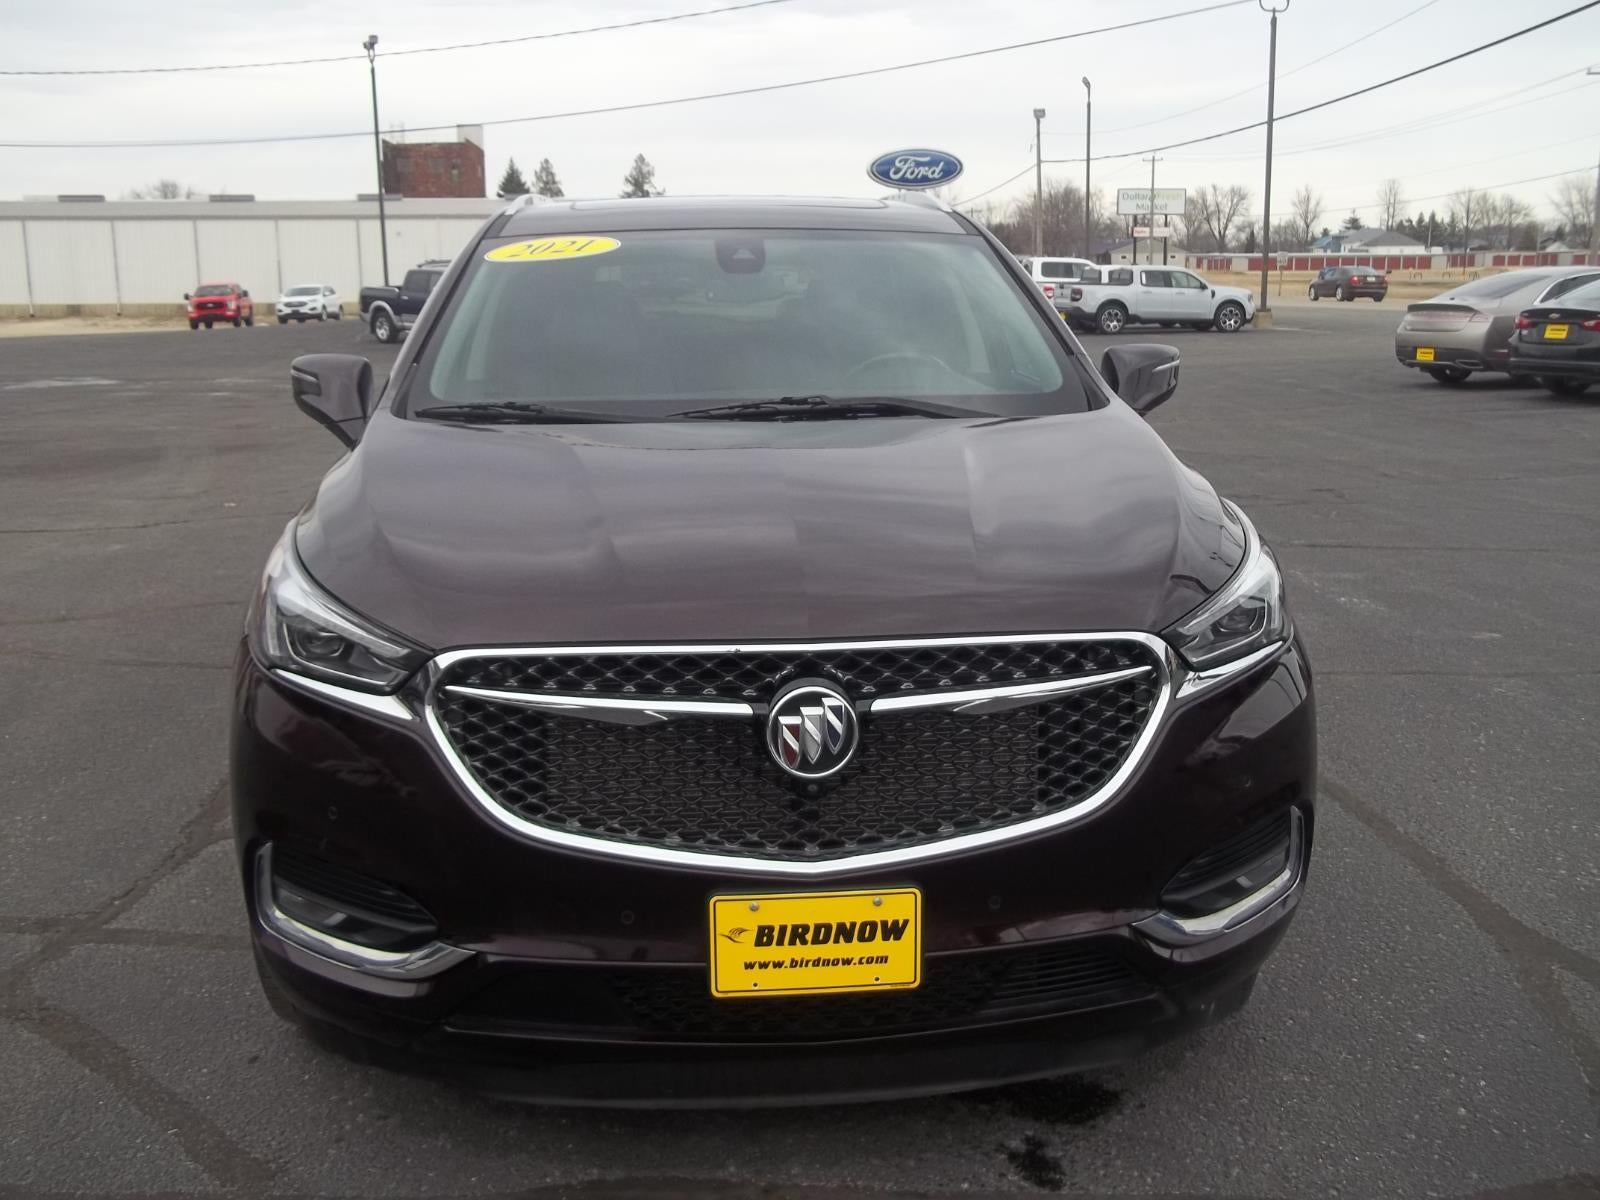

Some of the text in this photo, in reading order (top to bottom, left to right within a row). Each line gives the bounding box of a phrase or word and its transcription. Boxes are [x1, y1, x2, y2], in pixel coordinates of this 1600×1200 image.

[889, 155, 944, 180] Ford
[1135, 202, 1168, 211] Maket
[504, 238, 597, 258] 2021
[754, 918, 910, 948] BIRDNOW
[743, 954, 889, 971] www.birdnow.com
